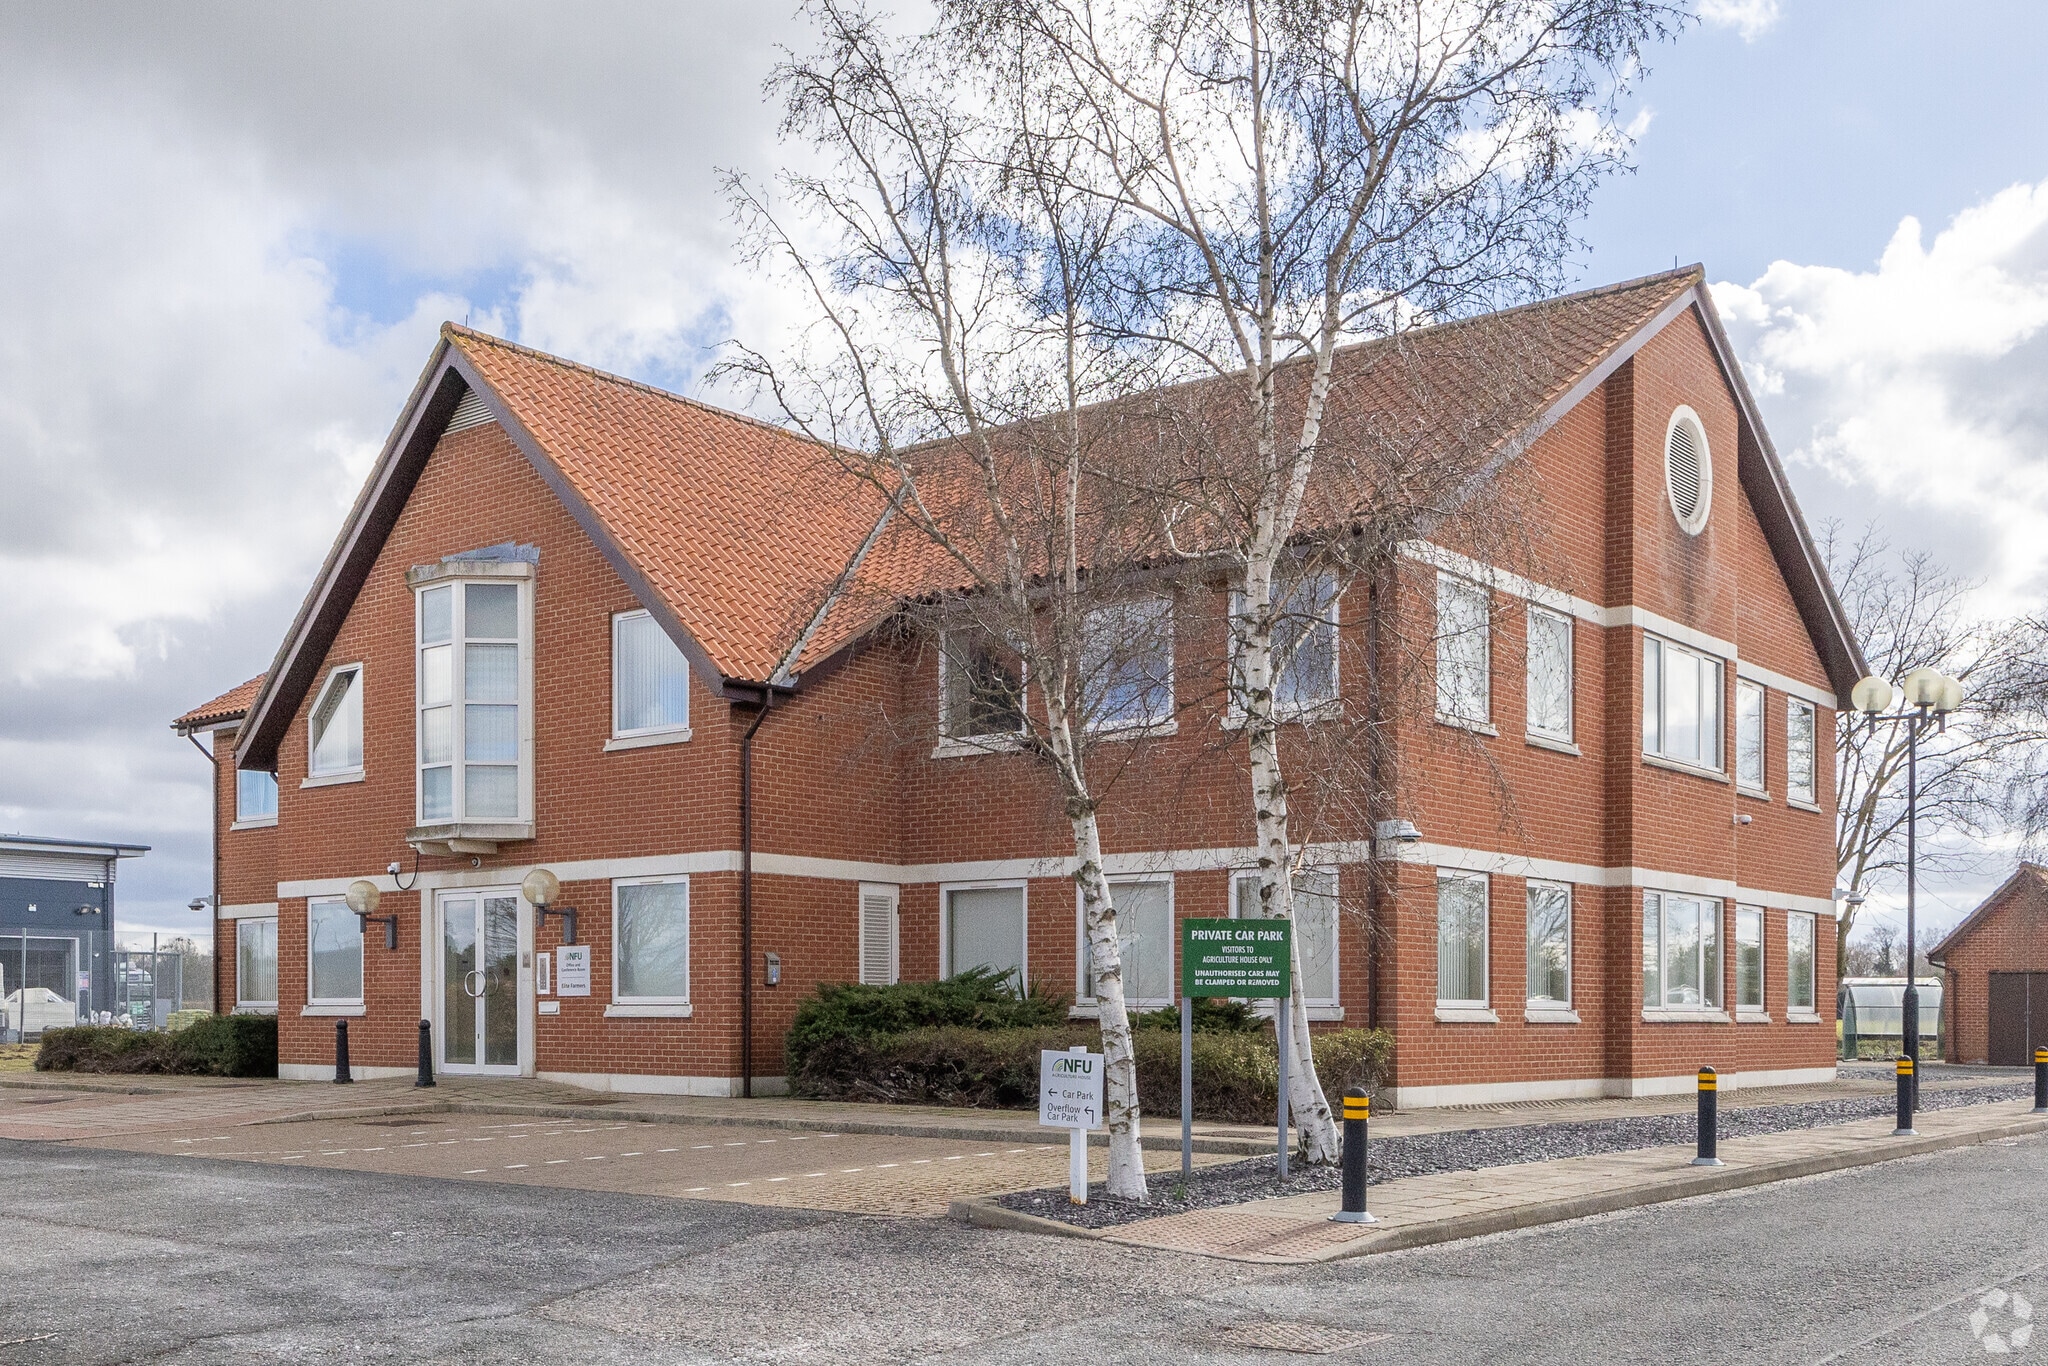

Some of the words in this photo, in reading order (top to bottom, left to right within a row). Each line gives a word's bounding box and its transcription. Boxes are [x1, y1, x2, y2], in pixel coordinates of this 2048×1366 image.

[1191, 930, 1232, 941] PRIVATE
[1235, 930, 1254, 941] CAR
[1257, 931, 1284, 941] PARK
[1221, 946, 1246, 954] VISITORS
[1246, 946, 1254, 954] TO
[569, 952, 582, 960] NFU
[1202, 956, 1239, 964] AGRICULTURE
[1239, 956, 1258, 964] HOUSE
[1259, 956, 1273, 964] ONLY
[1063, 1058, 1092, 1074] NFU
[1062, 1089, 1075, 1099] Car
[1076, 1091, 1094, 1100] Park
[1047, 1102, 1081, 1113] Overflow
[1047, 1112, 1059, 1120] Car
[1062, 1113, 1078, 1122] Park
